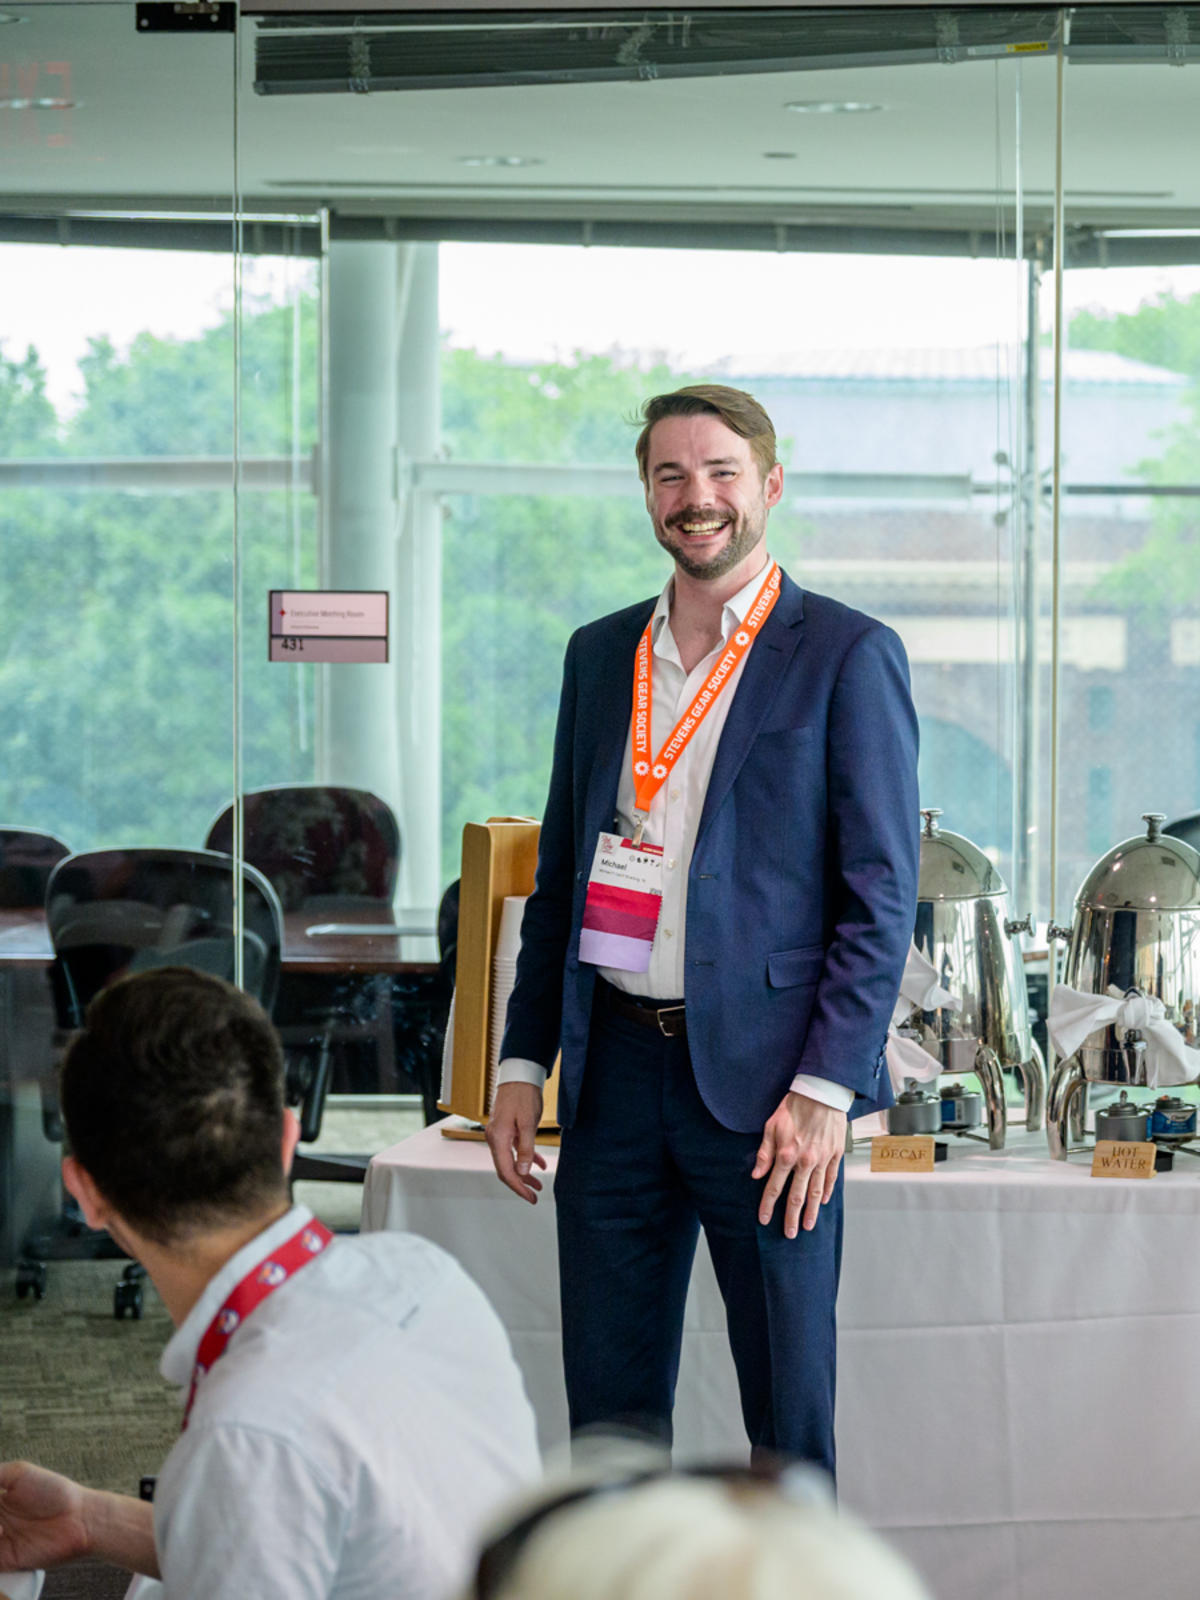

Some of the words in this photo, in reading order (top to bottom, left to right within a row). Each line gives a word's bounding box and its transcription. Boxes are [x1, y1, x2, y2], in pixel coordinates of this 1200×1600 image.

[747, 588, 775, 629] STEVENS
[281, 637, 304, 651] 431
[637, 635, 648, 680] STEVENS
[638, 681, 648, 710] GEAR
[664, 717, 697, 761] STEVENS
[691, 690, 713, 718] GEAR
[707, 650, 737, 692] SOCIETY
[636, 711, 647, 753] SOCIETY
[601, 858, 627, 871] Michael
[880, 1147, 928, 1161] DECAF
[1112, 1146, 1138, 1158] HOT
[1102, 1157, 1147, 1170] WATER
